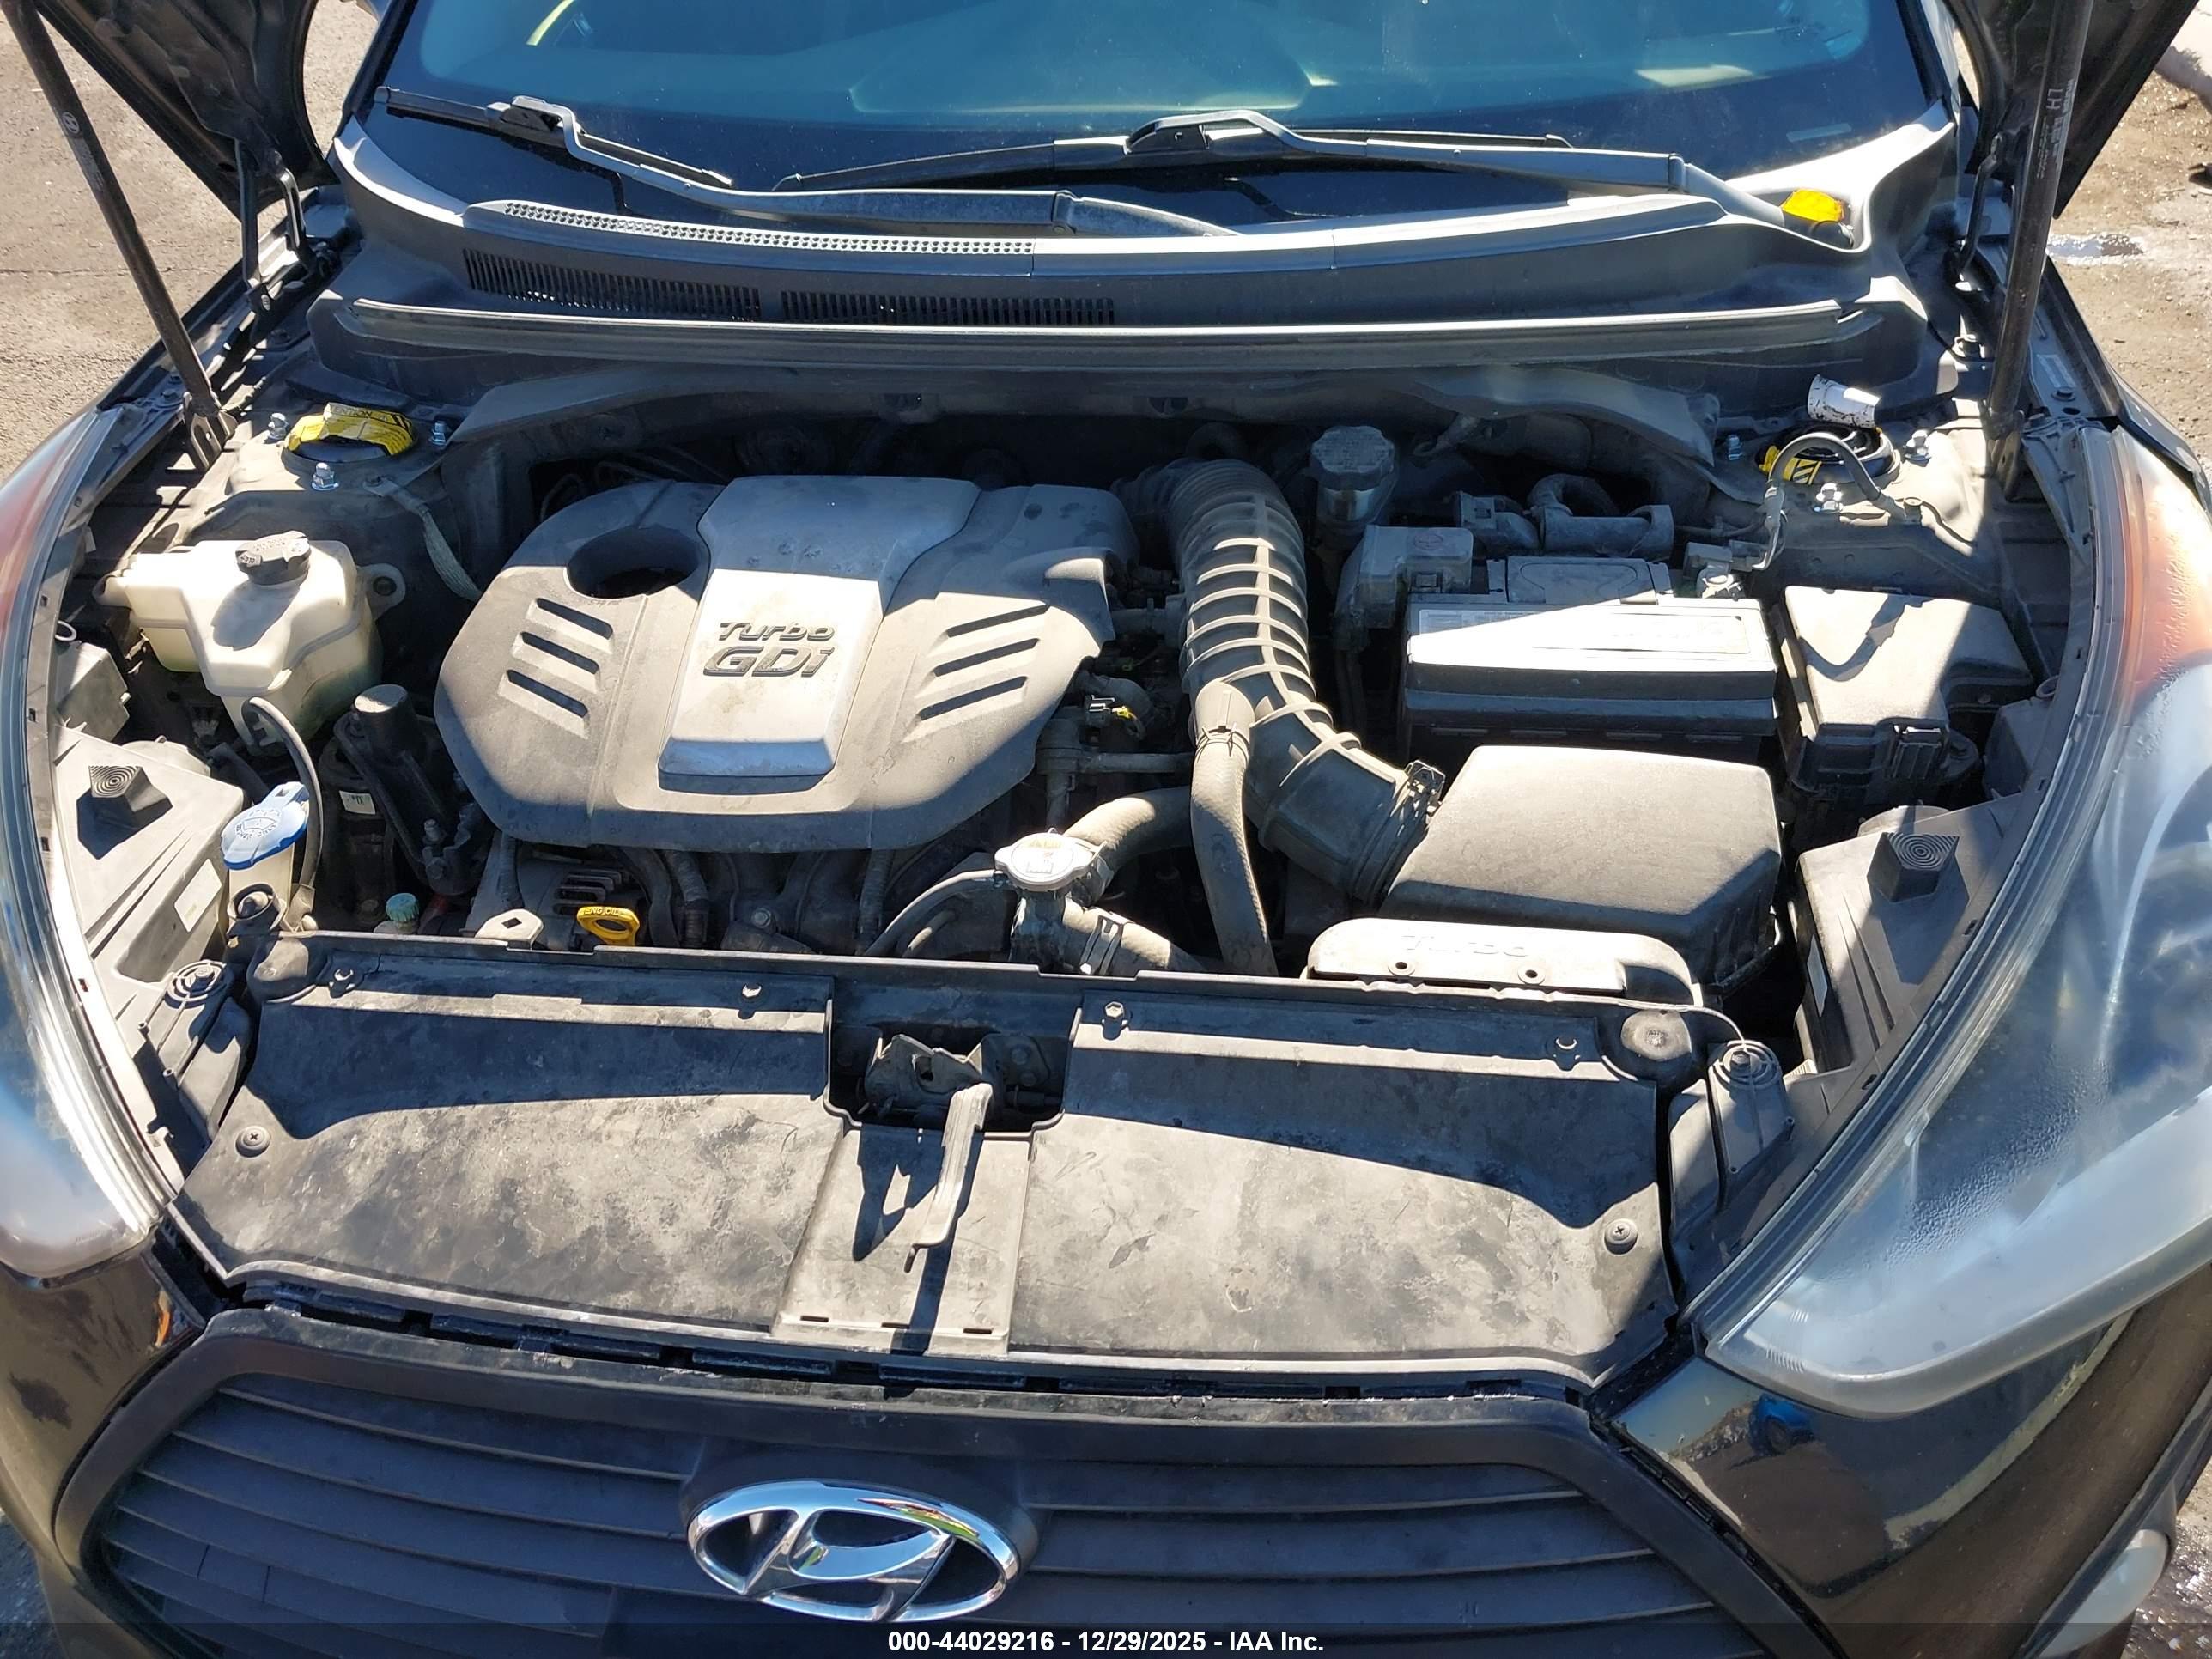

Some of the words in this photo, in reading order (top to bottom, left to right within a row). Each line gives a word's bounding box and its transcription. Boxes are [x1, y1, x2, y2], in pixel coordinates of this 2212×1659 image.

[2045, 88, 2063, 110] LH
[719, 621, 836, 641] Turbo
[702, 645, 836, 678] GDi
[584, 906, 604, 915] ENG
[605, 907, 620, 916] OIL
